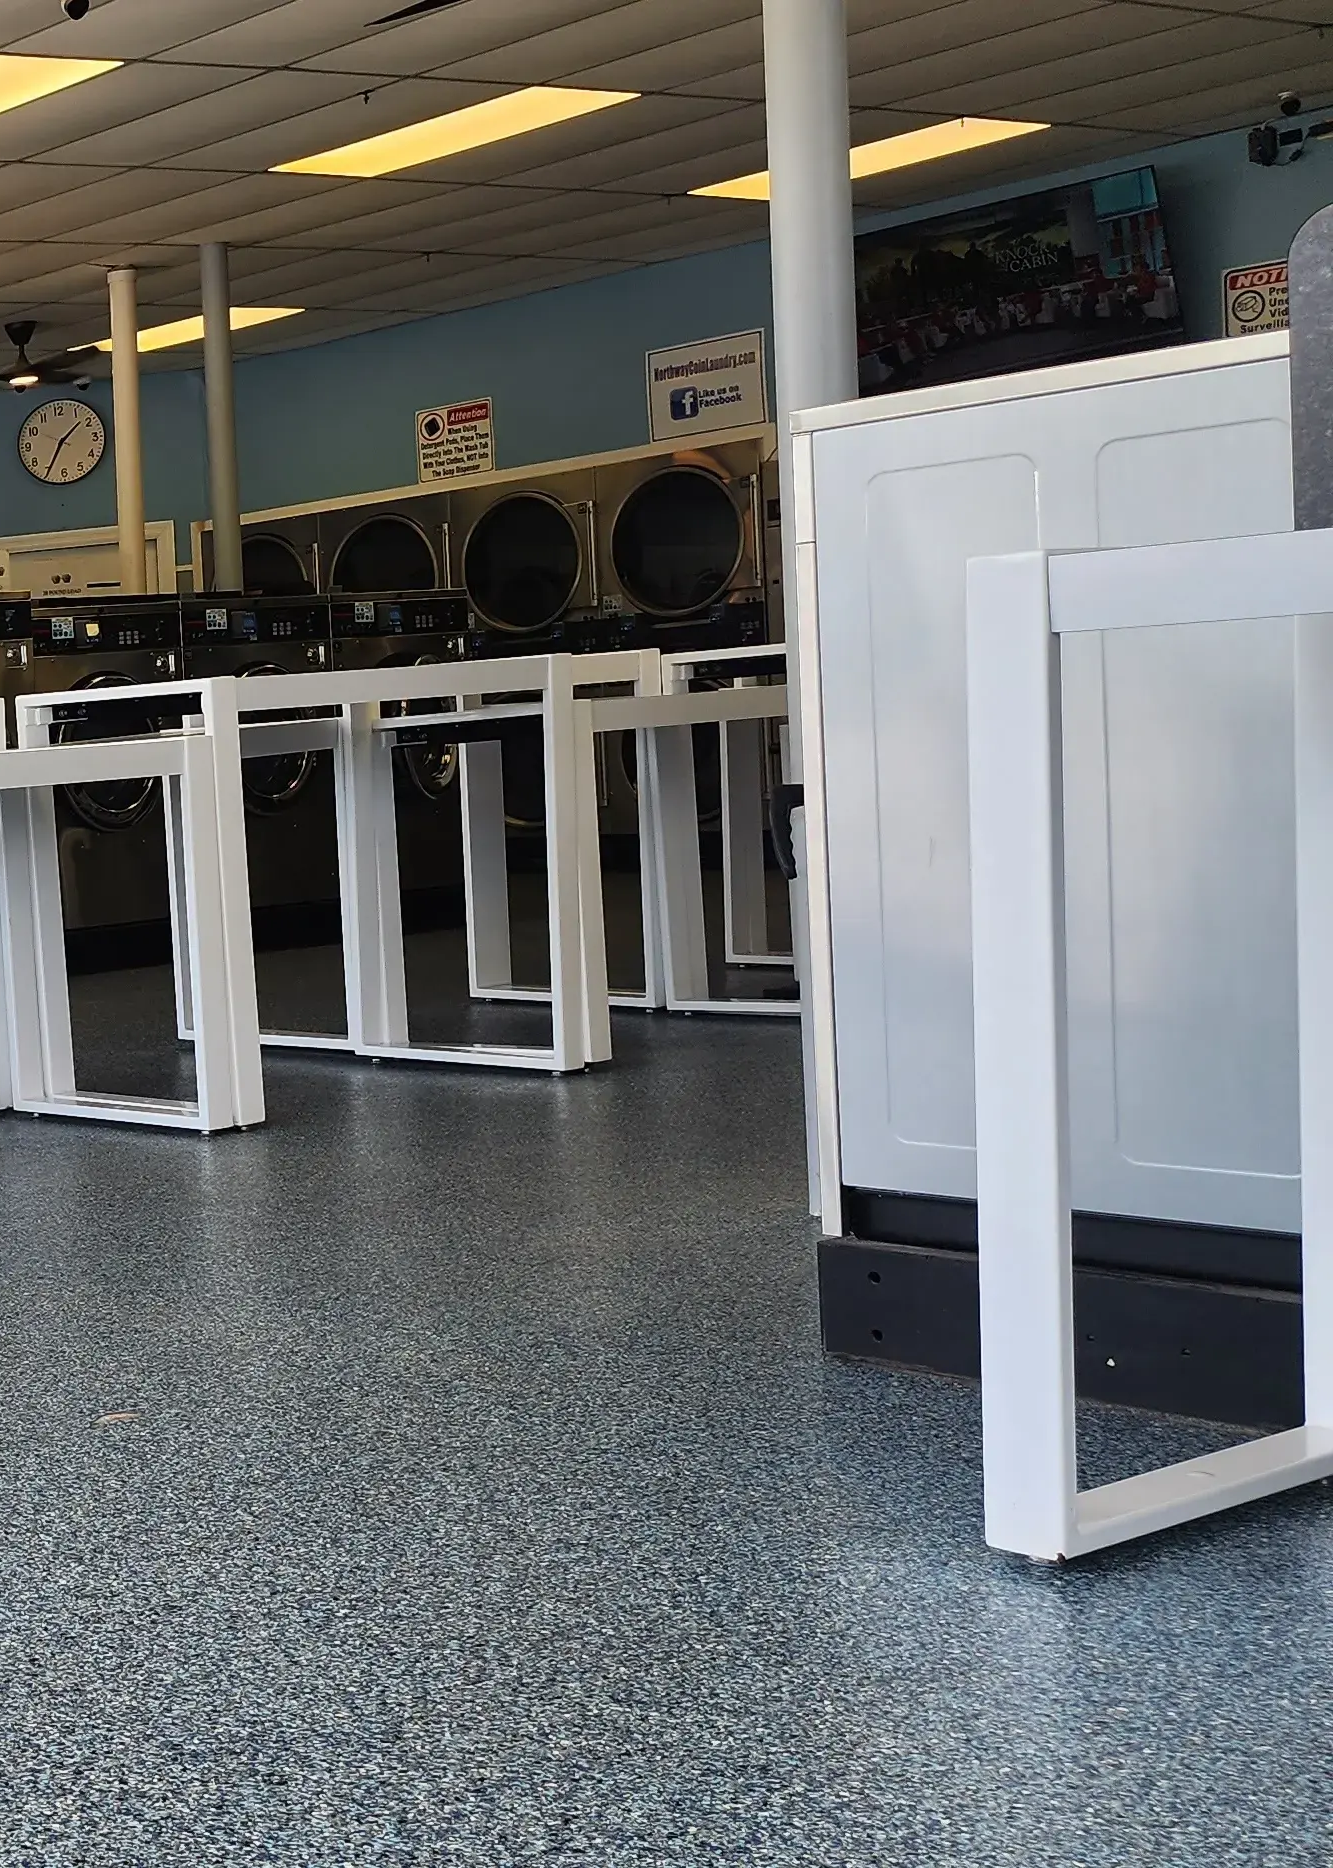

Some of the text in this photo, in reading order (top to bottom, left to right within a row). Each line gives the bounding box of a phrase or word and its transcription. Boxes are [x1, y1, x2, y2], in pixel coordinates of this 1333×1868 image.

[995, 244, 1049, 264] KNOCK
[1010, 252, 1057, 272] CABIN
[1235, 268, 1287, 288] NOTI
[1269, 286, 1288, 296] Pre
[1269, 309, 1289, 318] Vid
[1241, 320, 1289, 334] Surveilla
[654, 352, 755, 382] NorthwayCoinLaundry.com
[698, 388, 714, 398] Like
[717, 387, 726, 395] us
[699, 393, 742, 408] Facebook
[54, 406, 63, 416] 12
[449, 408, 486, 422] Attention
[40, 413, 46, 423] 11
[85, 417, 92, 427] 2
[29, 427, 38, 436] 10
[92, 432, 99, 441] 3
[25, 442, 31, 452] 9
[421, 440, 445, 450] Detergent
[88, 448, 94, 458] 4
[423, 451, 441, 460] Directly
[465, 444, 478, 452] Wash
[467, 453, 477, 461] NOT
[32, 457, 38, 467] 8
[77, 462, 83, 471] 5
[61, 468, 68, 477] 6
[442, 468, 454, 476] Soap
[456, 464, 480, 473] Dispenser
